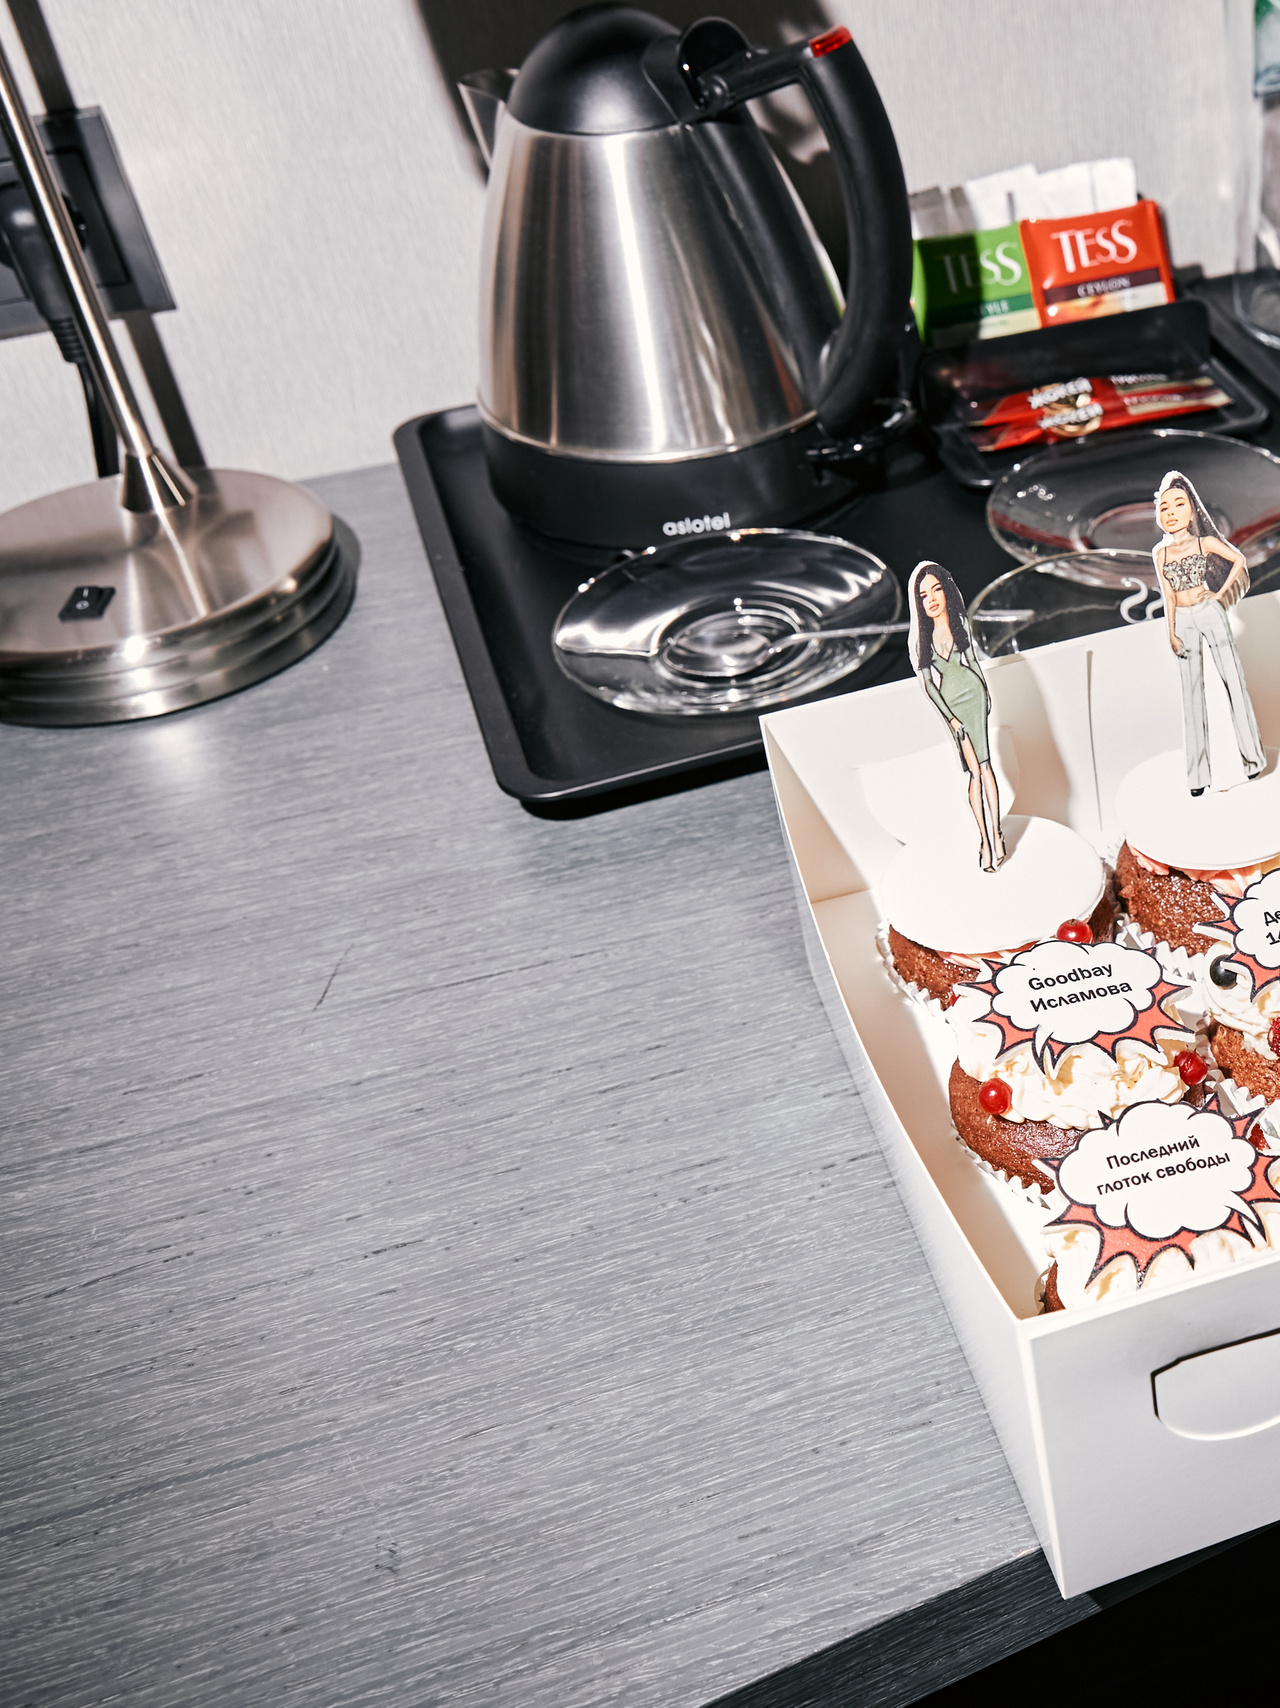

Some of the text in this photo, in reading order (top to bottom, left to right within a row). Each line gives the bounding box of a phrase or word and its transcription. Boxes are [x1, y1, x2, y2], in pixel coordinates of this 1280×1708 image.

[1050, 219, 1138, 273] TESS
[935, 242, 1022, 294] TESS
[1077, 276, 1131, 297] CEYLON
[1028, 964, 1113, 990] Goodbay
[1030, 981, 1132, 1012] Исламова
[1106, 1135, 1200, 1169] Последний
[1097, 1152, 1231, 1195] глоток свободы
